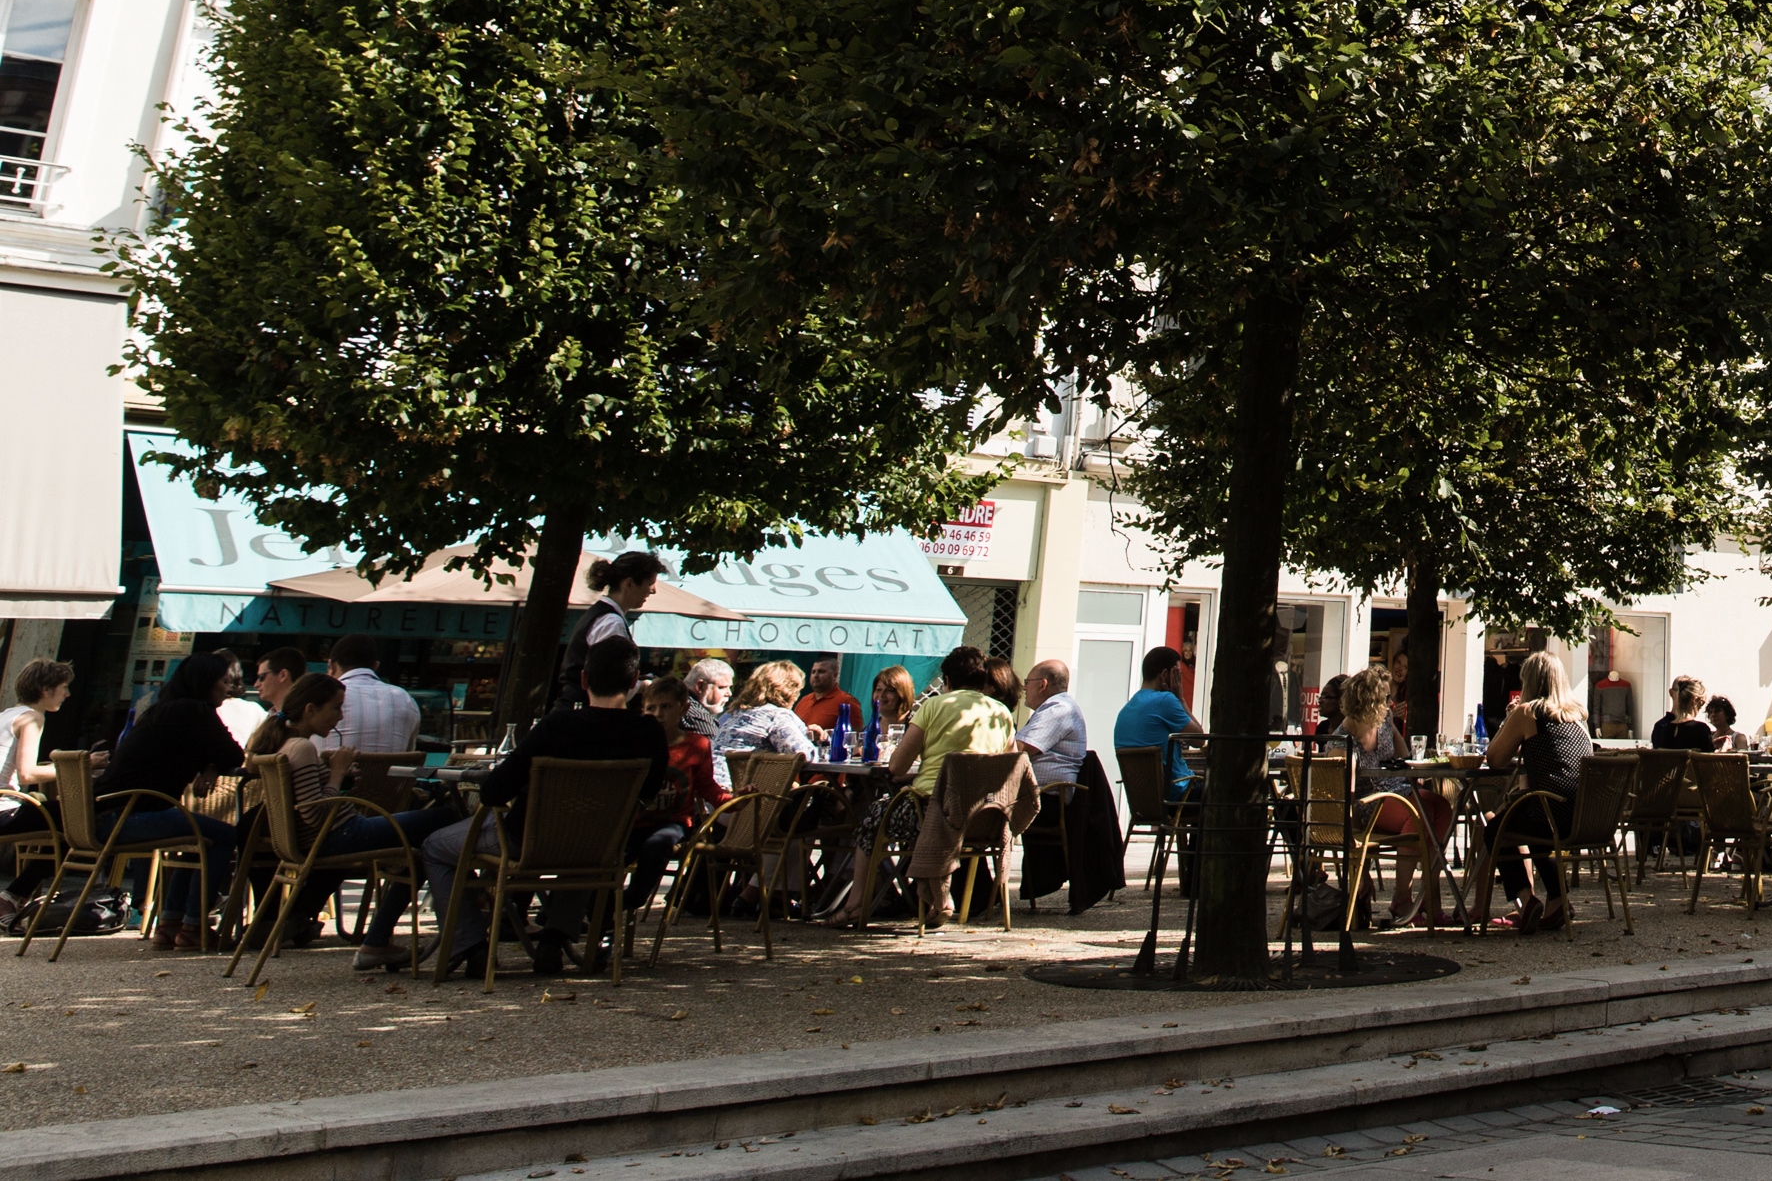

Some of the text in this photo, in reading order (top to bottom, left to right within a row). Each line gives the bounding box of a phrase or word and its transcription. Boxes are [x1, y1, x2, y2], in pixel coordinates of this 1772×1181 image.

[933, 543, 945, 554] 09
[947, 544, 960, 555] 09
[962, 545, 974, 556] 69
[977, 546, 988, 557] 72
[690, 620, 923, 649] CHOCOLAT
